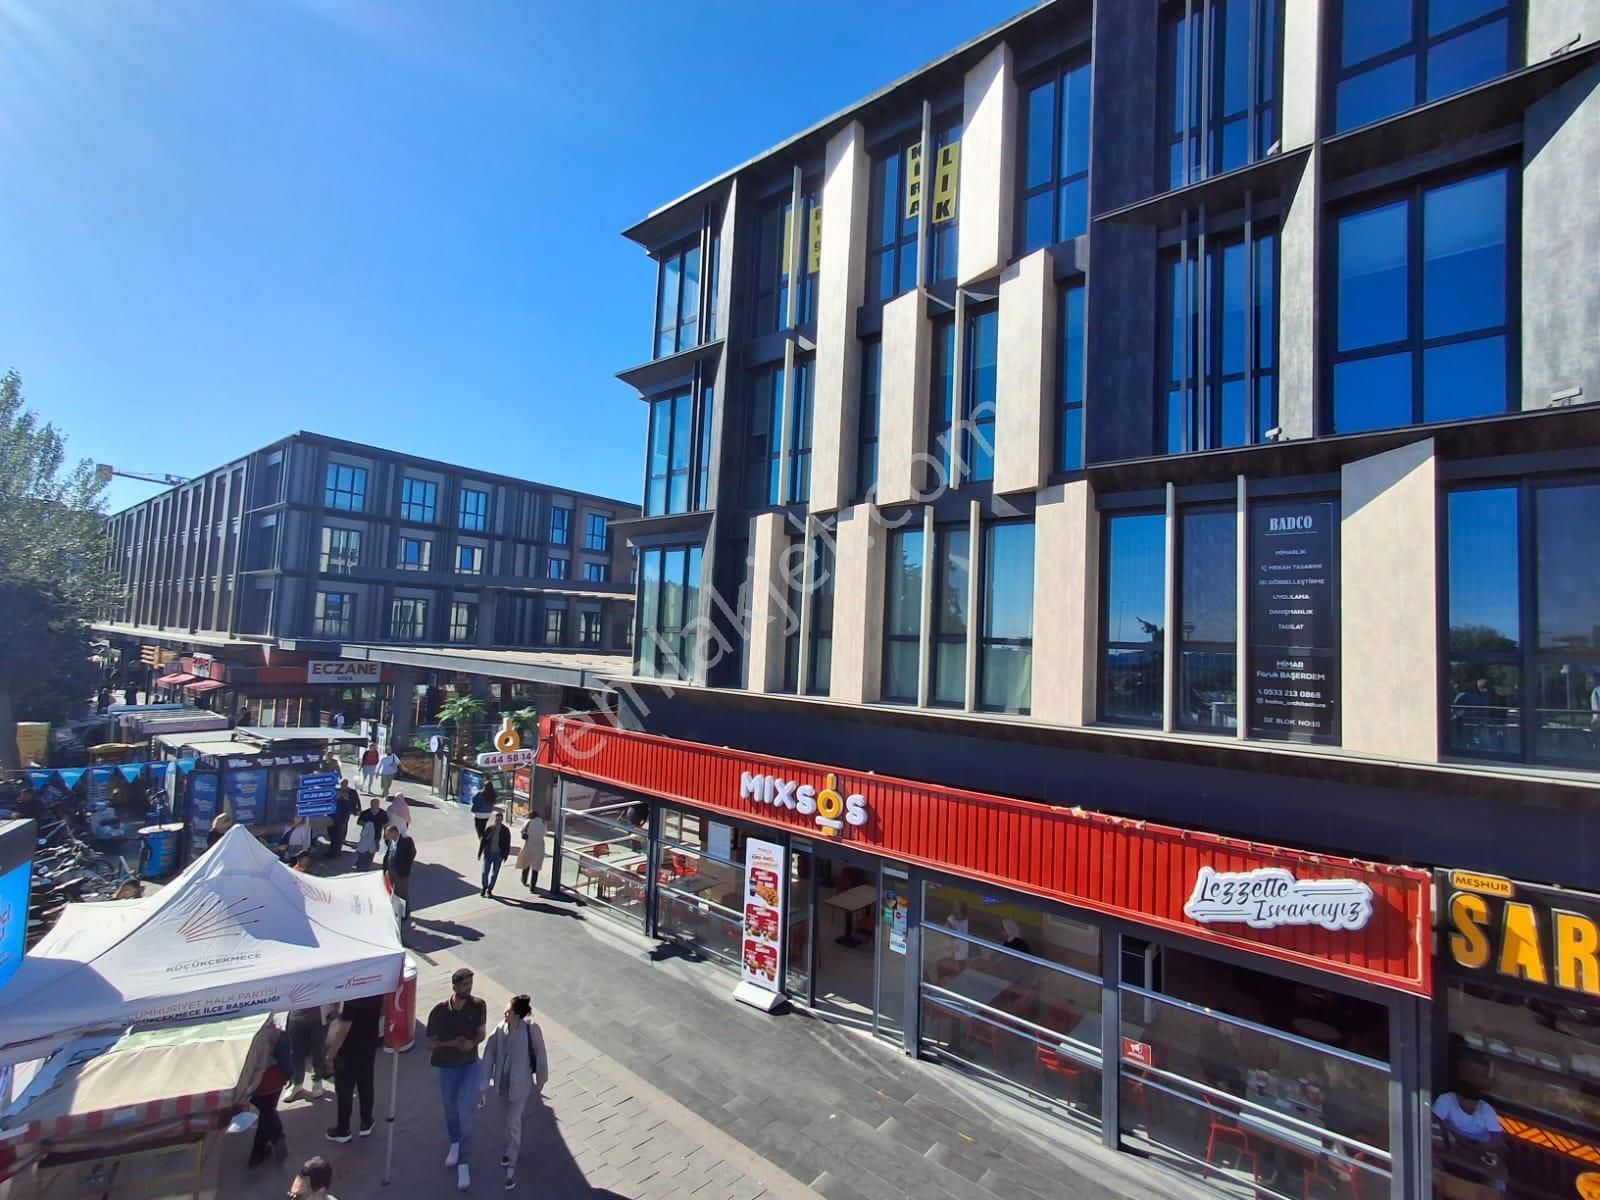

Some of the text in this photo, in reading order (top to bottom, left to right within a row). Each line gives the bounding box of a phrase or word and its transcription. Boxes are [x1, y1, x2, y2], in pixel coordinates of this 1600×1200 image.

[935, 148, 953, 220] LIK
[1269, 515, 1313, 531] BADCO
[1268, 608, 1314, 617] DANIŞMANLIK
[311, 663, 377, 675] ECZANE
[1276, 659, 1304, 669] MİMAR
[1279, 671, 1326, 681] BAŞERDEM
[1263, 688, 1283, 696] 0533
[1275, 717, 1296, 726] BLOK
[484, 752, 532, 765] 444 58 14
[1196, 877, 1289, 905] Lezzette
[205, 993, 235, 1006] HALK
